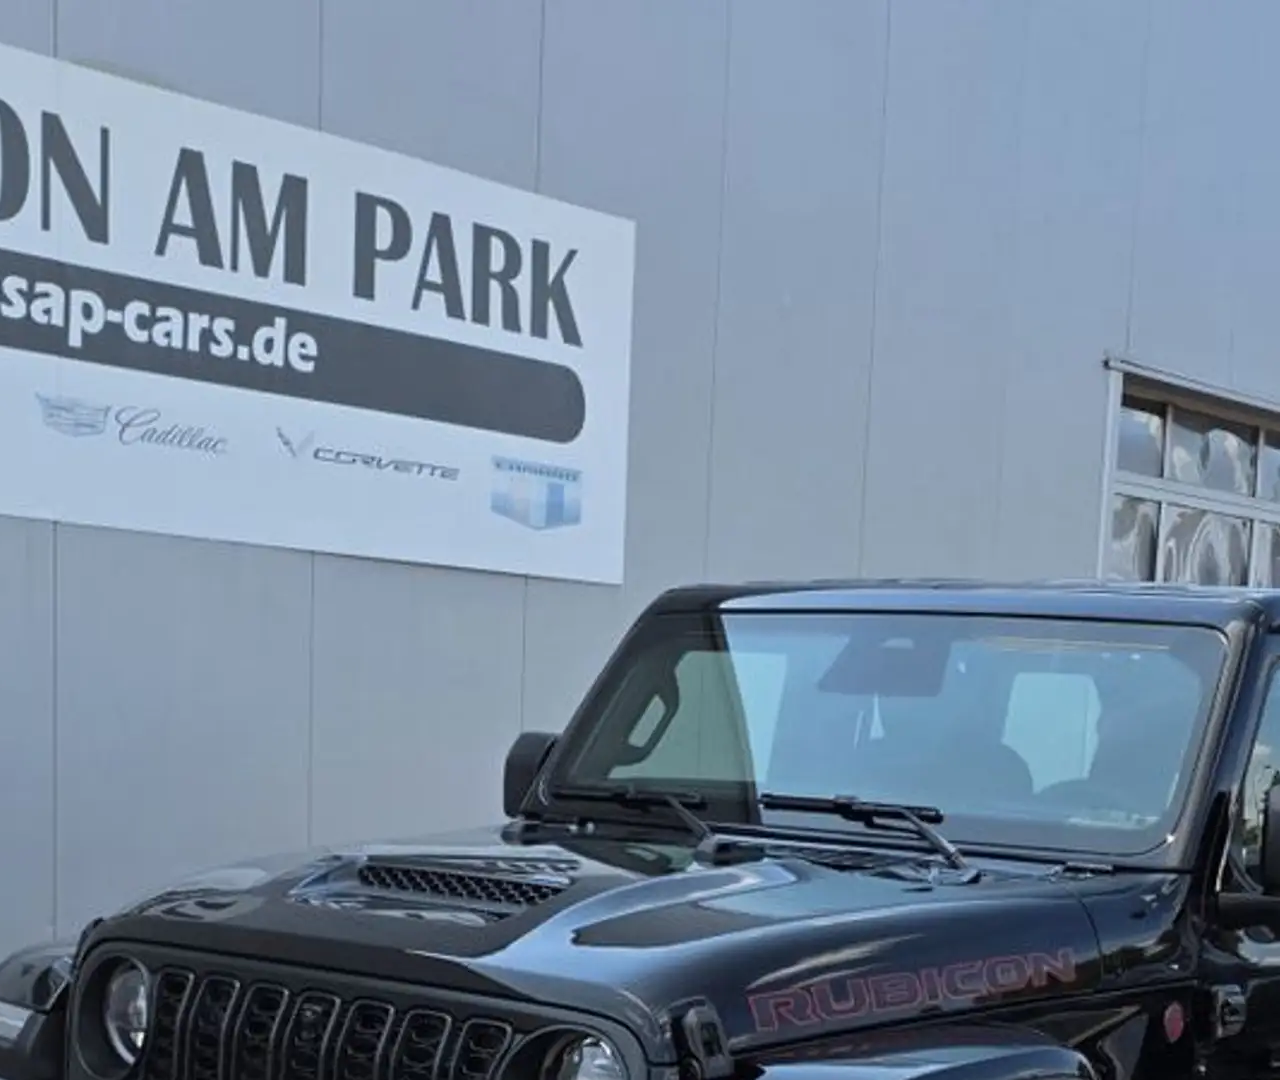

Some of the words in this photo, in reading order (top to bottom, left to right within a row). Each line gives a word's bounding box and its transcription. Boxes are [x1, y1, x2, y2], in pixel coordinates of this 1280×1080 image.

[154, 146, 309, 287] AM
[352, 190, 584, 348] PARK
[114, 408, 229, 454] Cadillac
[313, 447, 461, 482] CORVETTE
[748, 948, 1077, 1034] RUBICON
